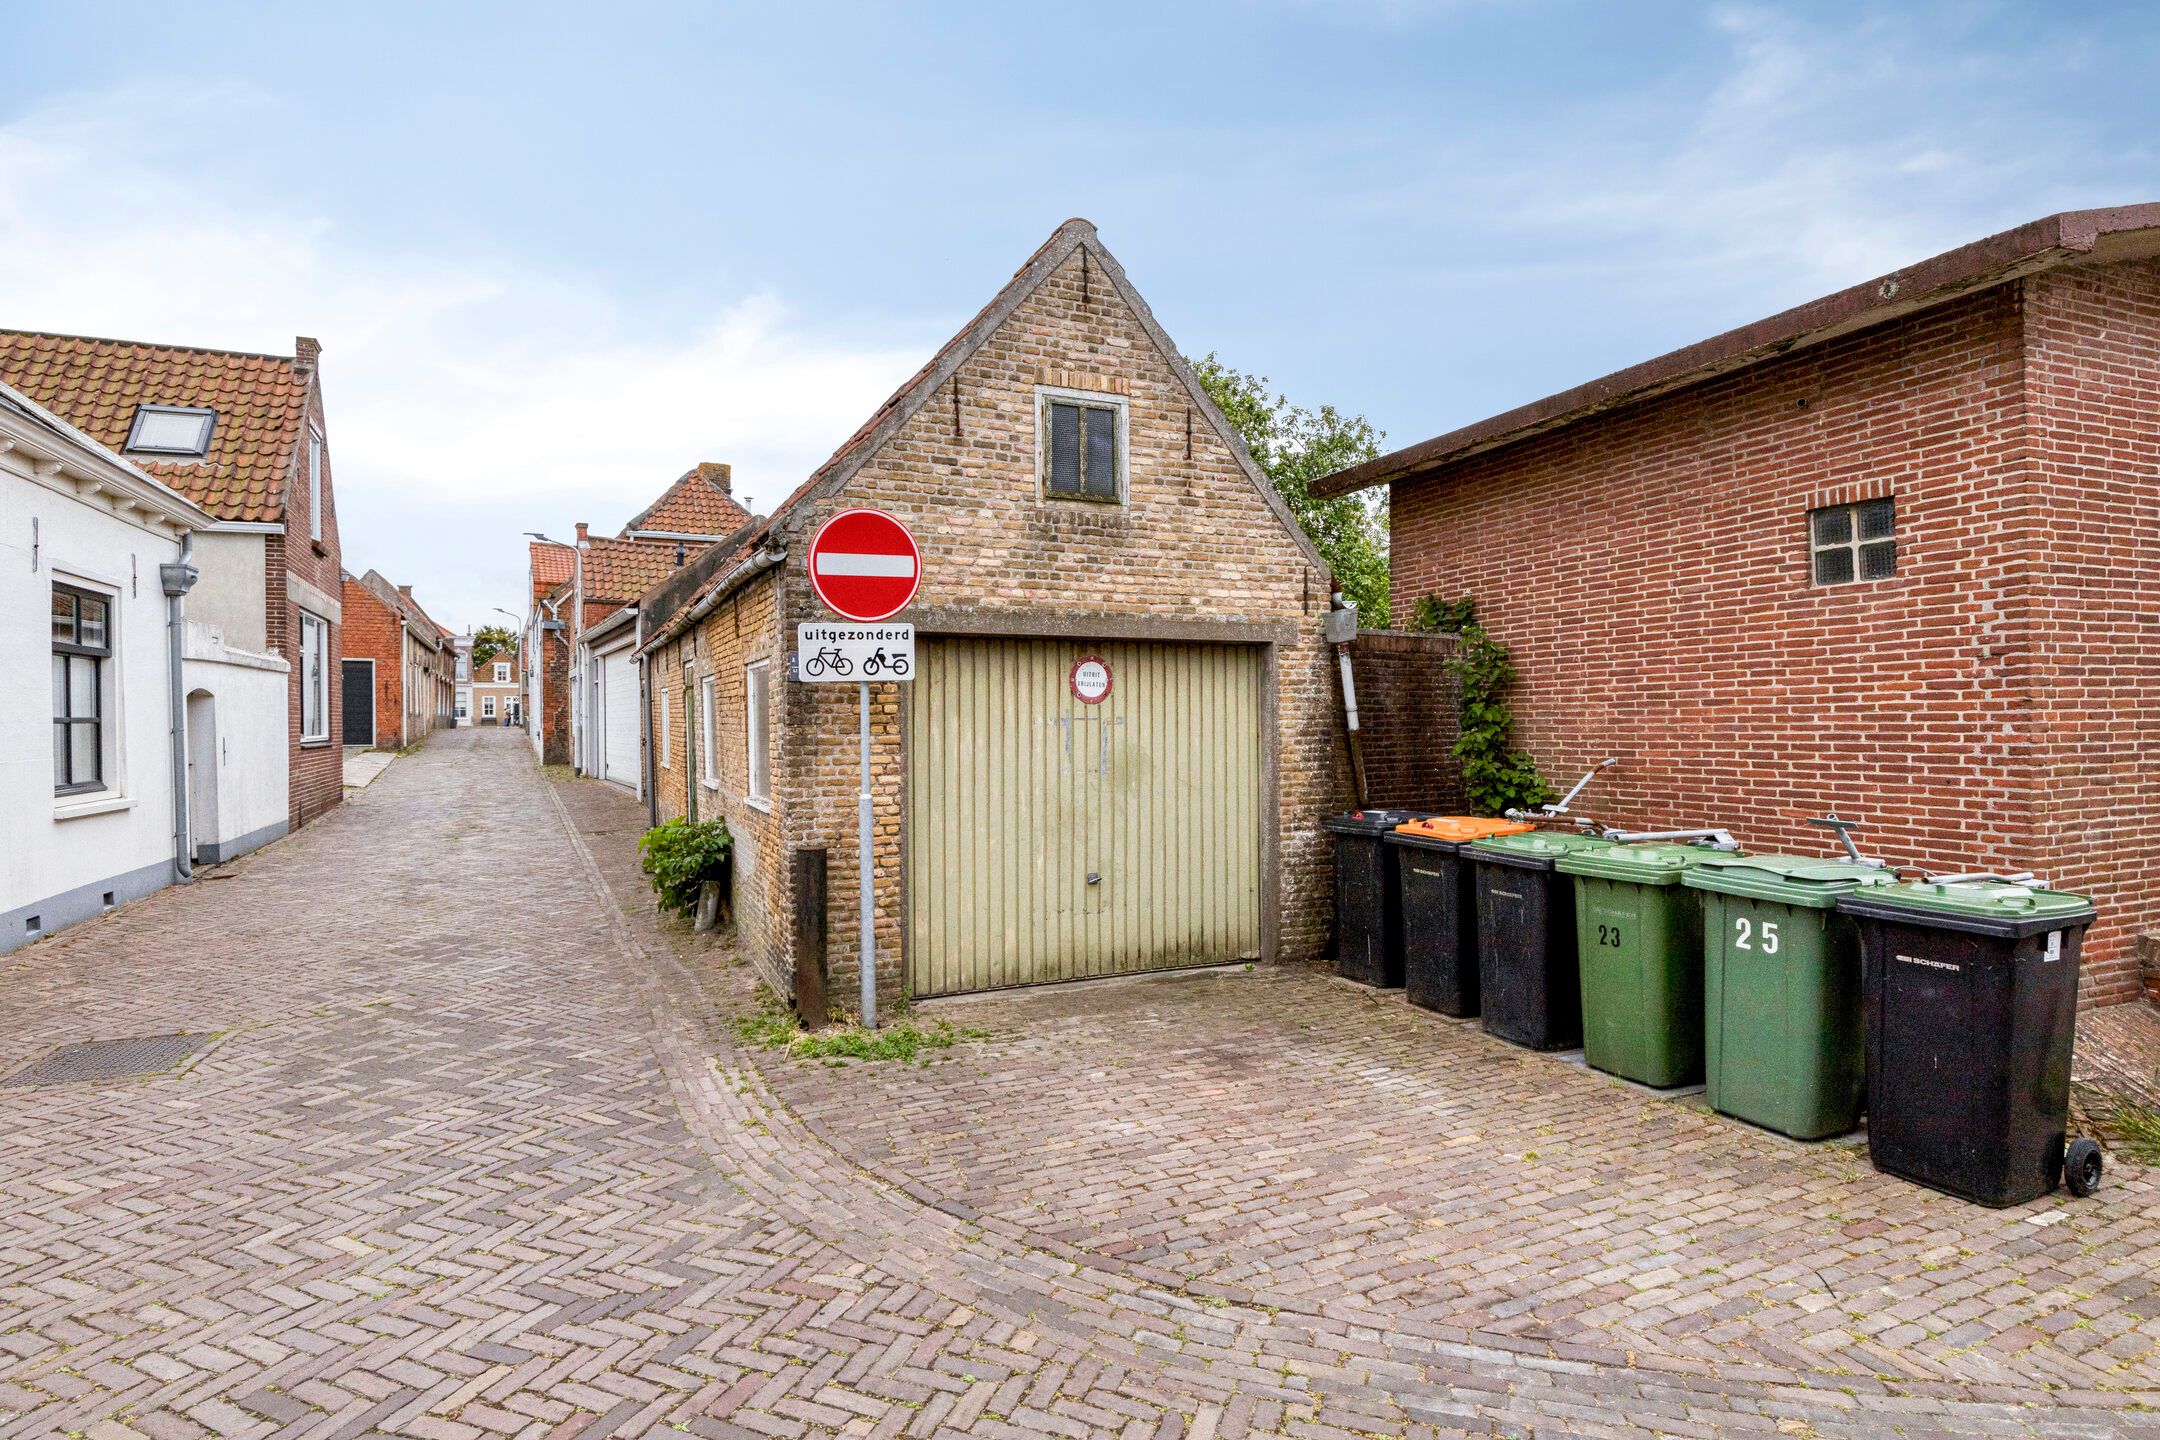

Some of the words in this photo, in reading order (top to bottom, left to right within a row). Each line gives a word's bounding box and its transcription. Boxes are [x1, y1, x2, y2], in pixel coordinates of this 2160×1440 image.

[805, 629, 909, 643] uitgezonderd
[1599, 924, 1620, 947] 23
[1735, 917, 1779, 954] 25
